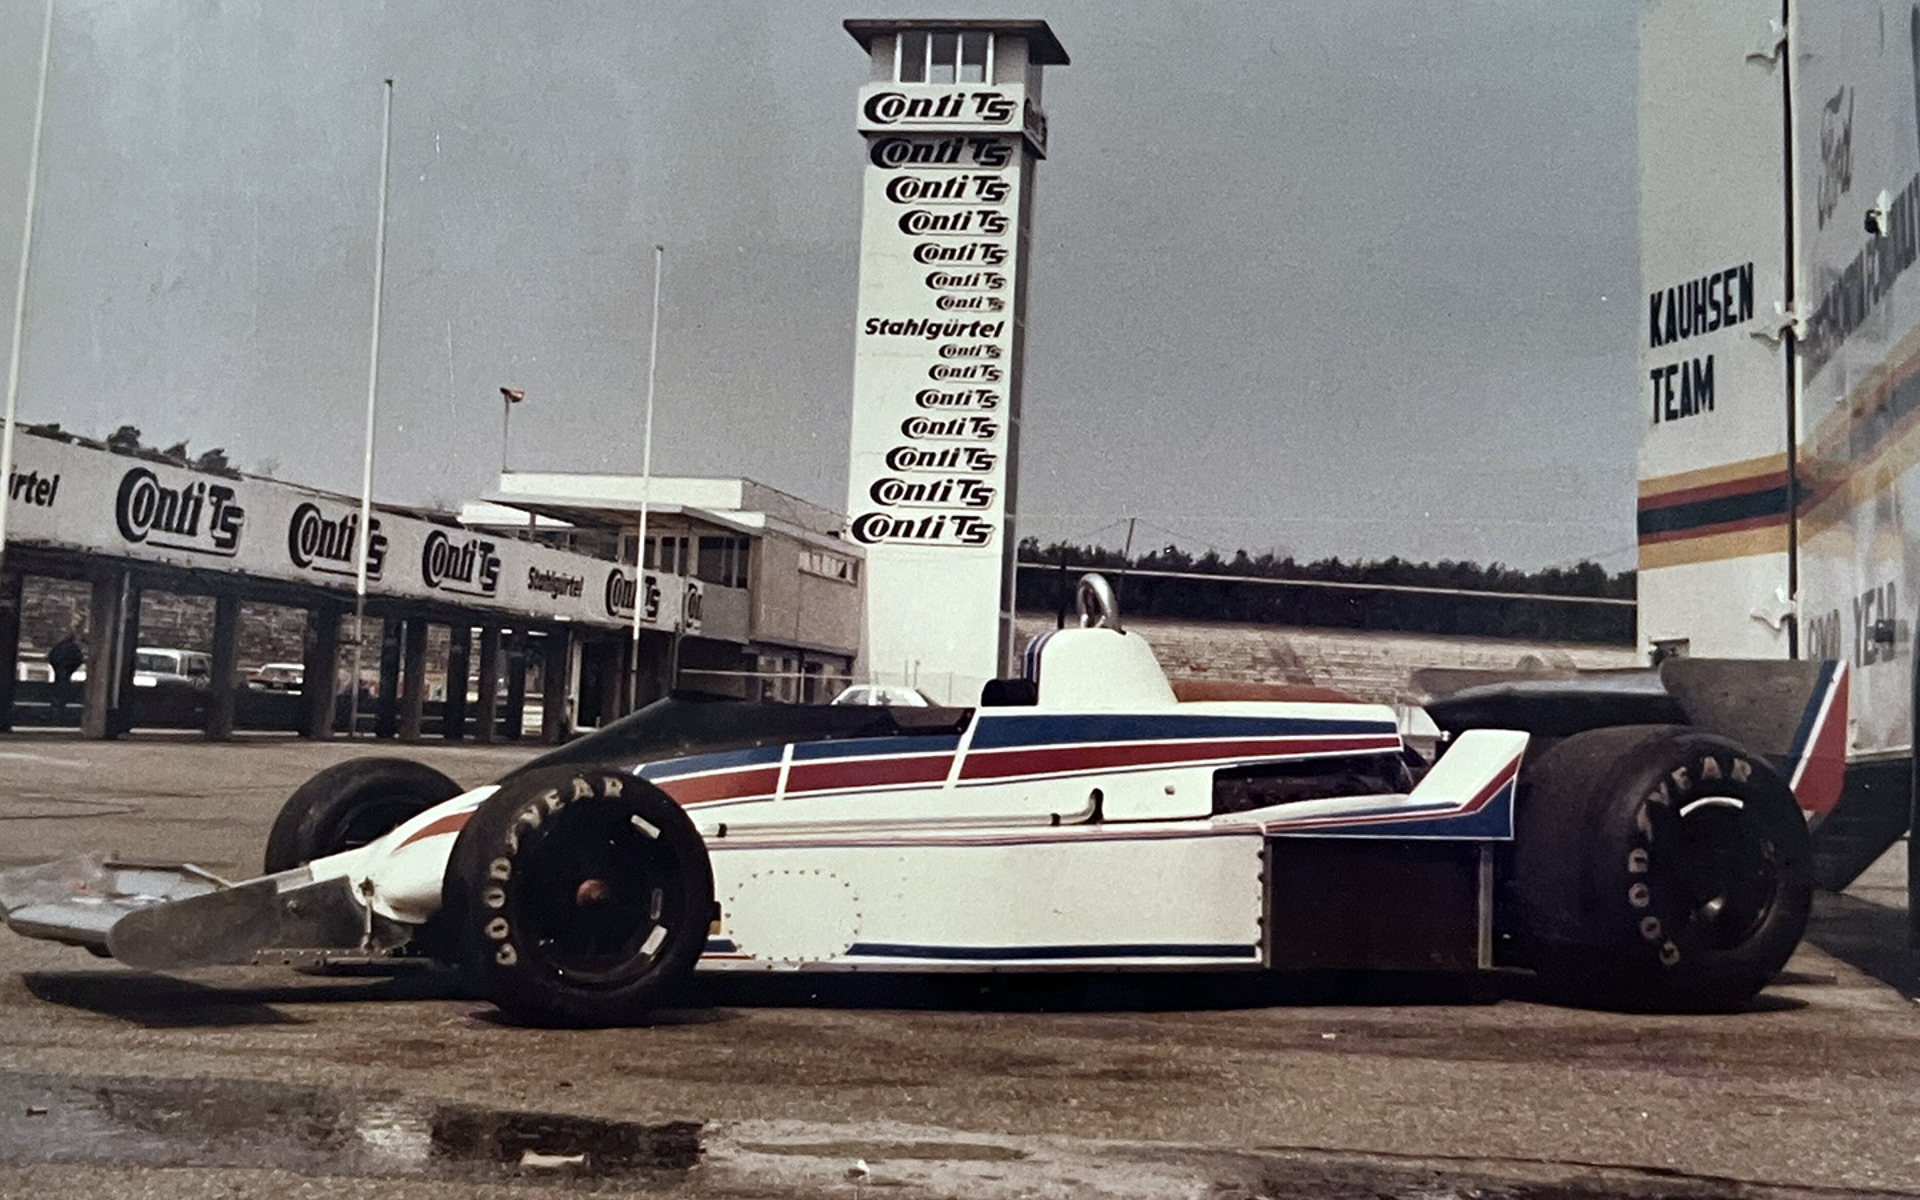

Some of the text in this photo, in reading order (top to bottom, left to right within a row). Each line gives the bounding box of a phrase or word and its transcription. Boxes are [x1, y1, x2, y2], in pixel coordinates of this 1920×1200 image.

[863, 92, 966, 124] Conti
[870, 137, 964, 169] Conti
[885, 175, 970, 204] Conti
[898, 210, 973, 235] Conti
[913, 242, 978, 264] Conti
[925, 271, 981, 290] Conti
[935, 295, 983, 311] Conti
[1649, 261, 1755, 349] KAUHSEN
[865, 317, 1005, 340] Stahlgürtel
[938, 344, 983, 359] Conti
[928, 364, 977, 381] Conti
[915, 389, 973, 409] Conti
[1649, 354, 1715, 425] TEAM
[901, 416, 966, 439] Conti
[885, 446, 961, 472] Conti
[116, 467, 205, 543] Conti
[869, 477, 954, 506] Conti
[288, 502, 358, 569] Conti
[851, 512, 947, 544] Conti
[422, 530, 477, 588] Conti
